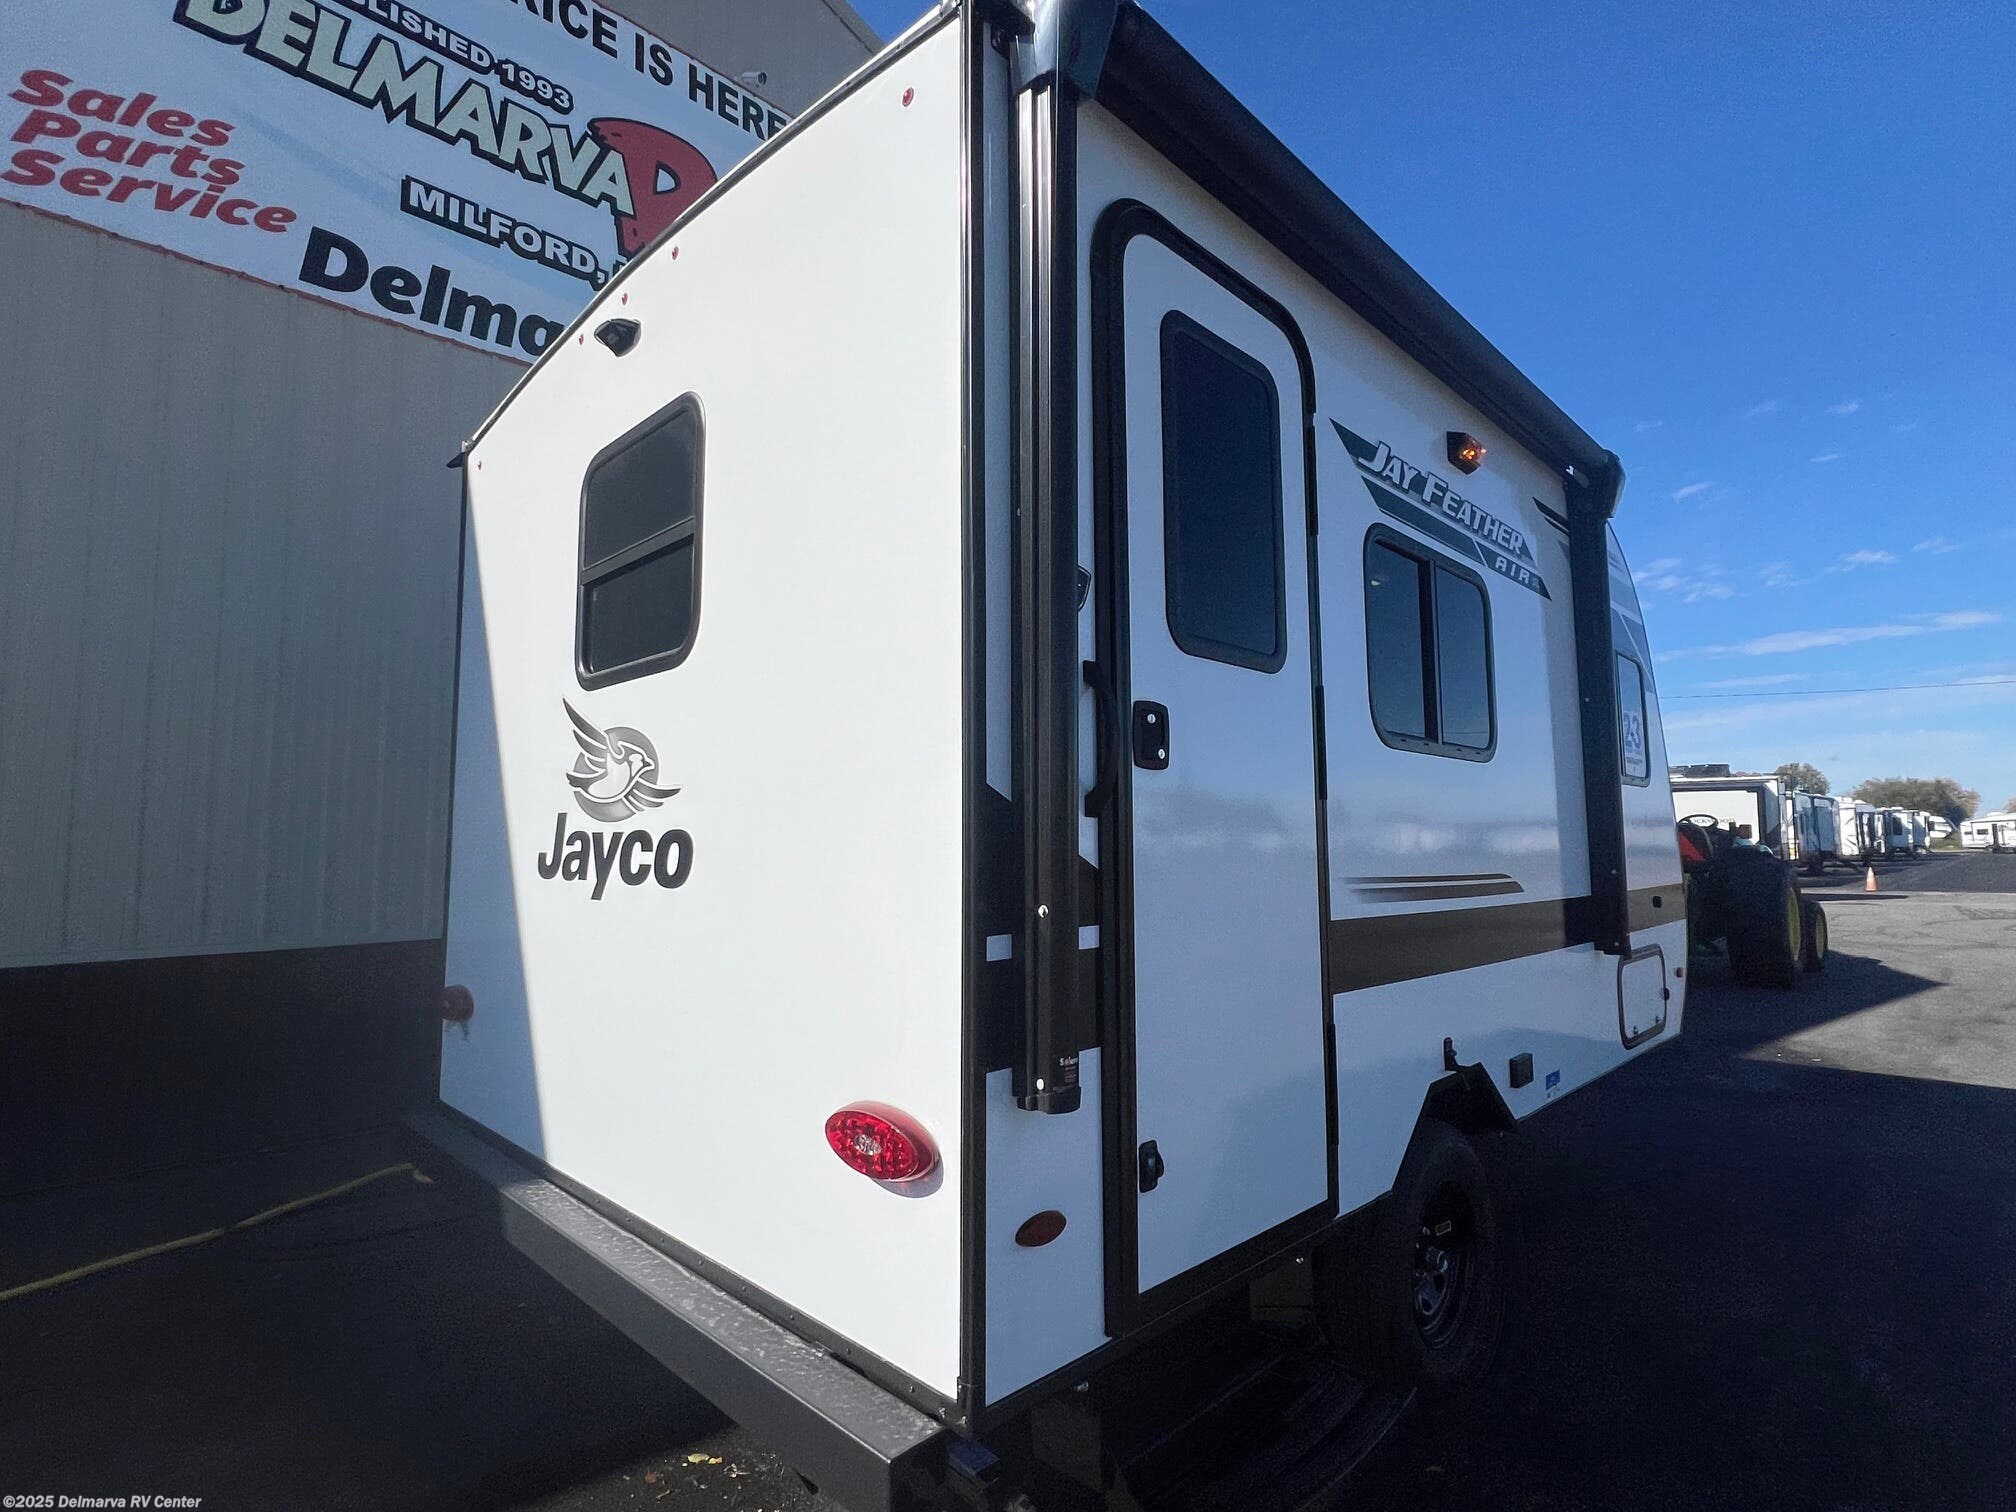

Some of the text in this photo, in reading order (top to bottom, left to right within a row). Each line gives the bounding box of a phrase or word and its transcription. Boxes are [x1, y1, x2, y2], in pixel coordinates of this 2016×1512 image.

[352, 0, 571, 109] LISHED 1993
[634, 31, 674, 87] IS
[688, 59, 787, 141] HERE
[8, 69, 235, 146] Sales
[10, 109, 245, 186] Parts
[0, 149, 298, 233] Service
[407, 179, 607, 285] MILFORD,
[298, 227, 565, 357] Delma
[537, 812, 694, 900] Jayco
